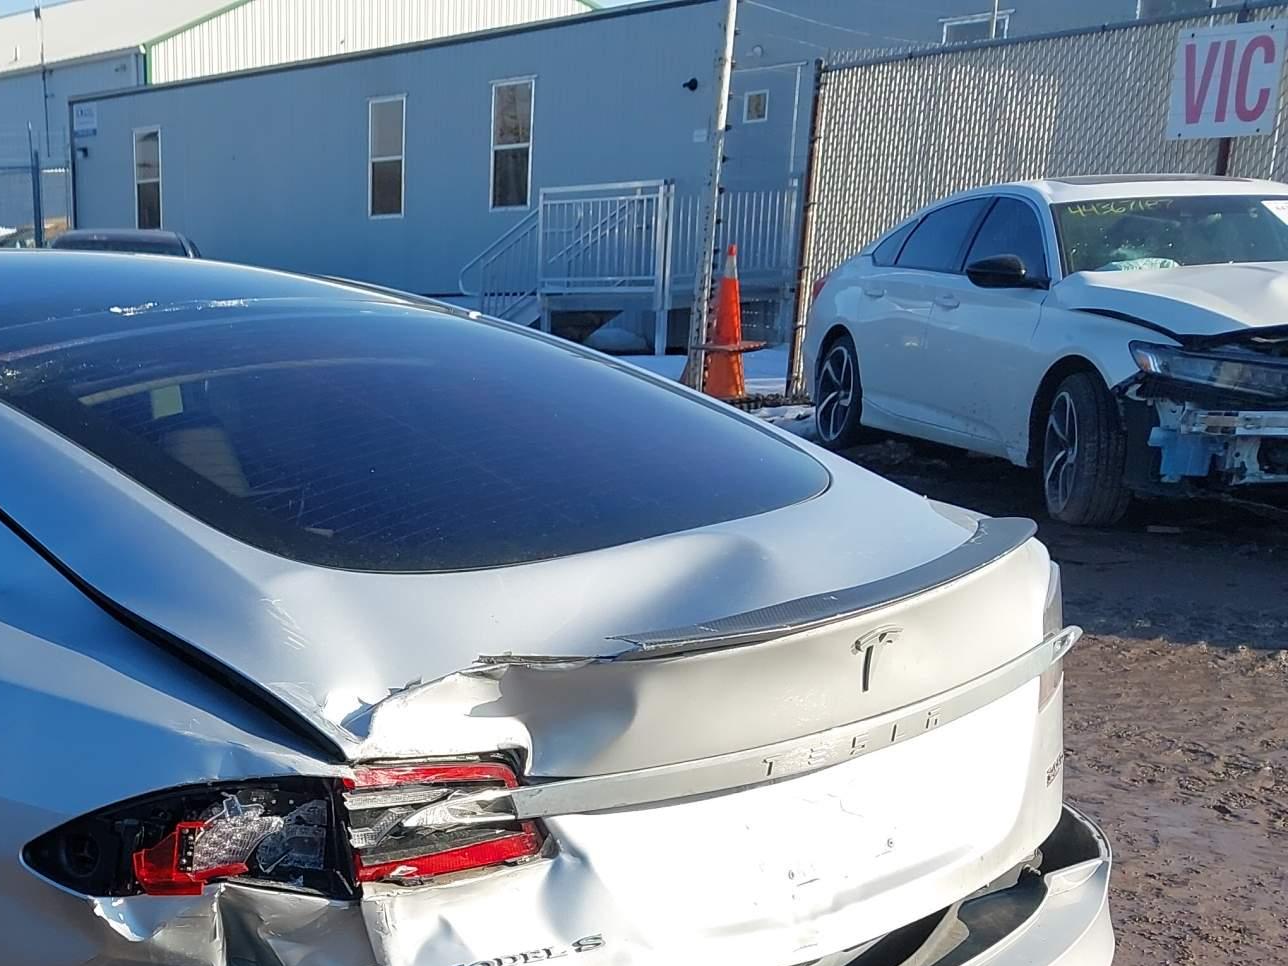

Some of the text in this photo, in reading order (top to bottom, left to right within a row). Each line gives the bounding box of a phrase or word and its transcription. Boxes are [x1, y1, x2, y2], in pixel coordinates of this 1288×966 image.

[1185, 35, 1276, 124] VIC
[762, 707, 942, 777] TESLA
[571, 933, 607, 955] S
